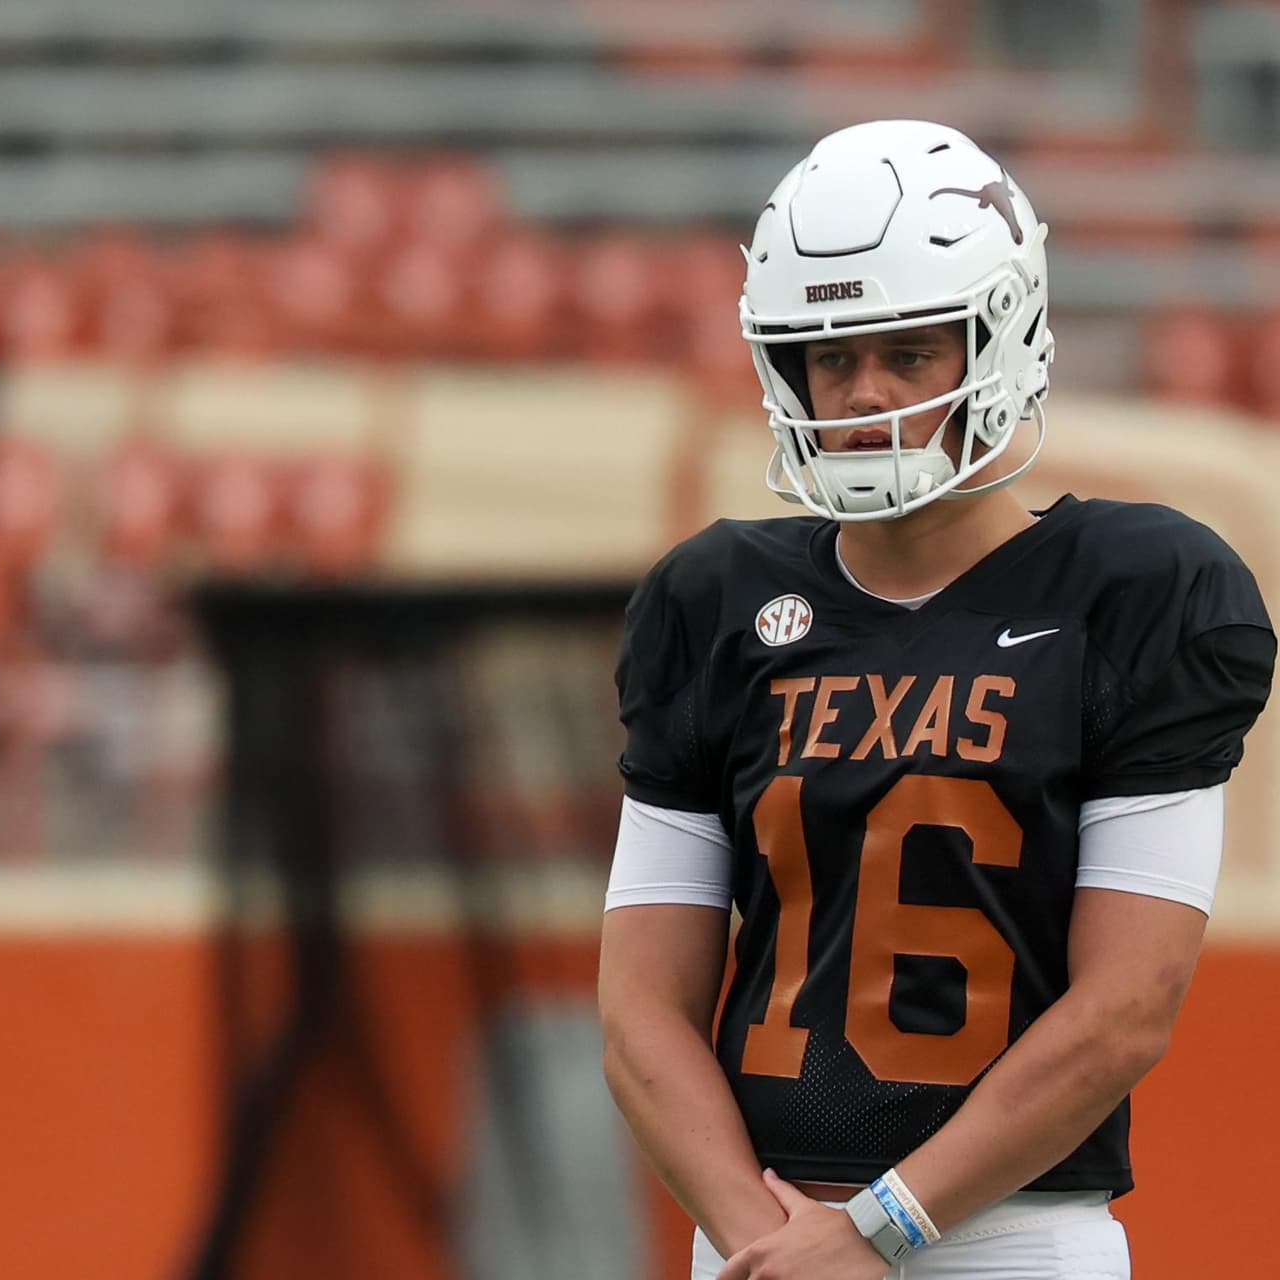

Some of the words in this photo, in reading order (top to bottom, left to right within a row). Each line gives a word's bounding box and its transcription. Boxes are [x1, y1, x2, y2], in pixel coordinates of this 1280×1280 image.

[805, 280, 864, 304] HORNS
[759, 598, 808, 643] SEC
[770, 673, 1017, 766] TEXAS
[740, 774, 1024, 1086] 16
